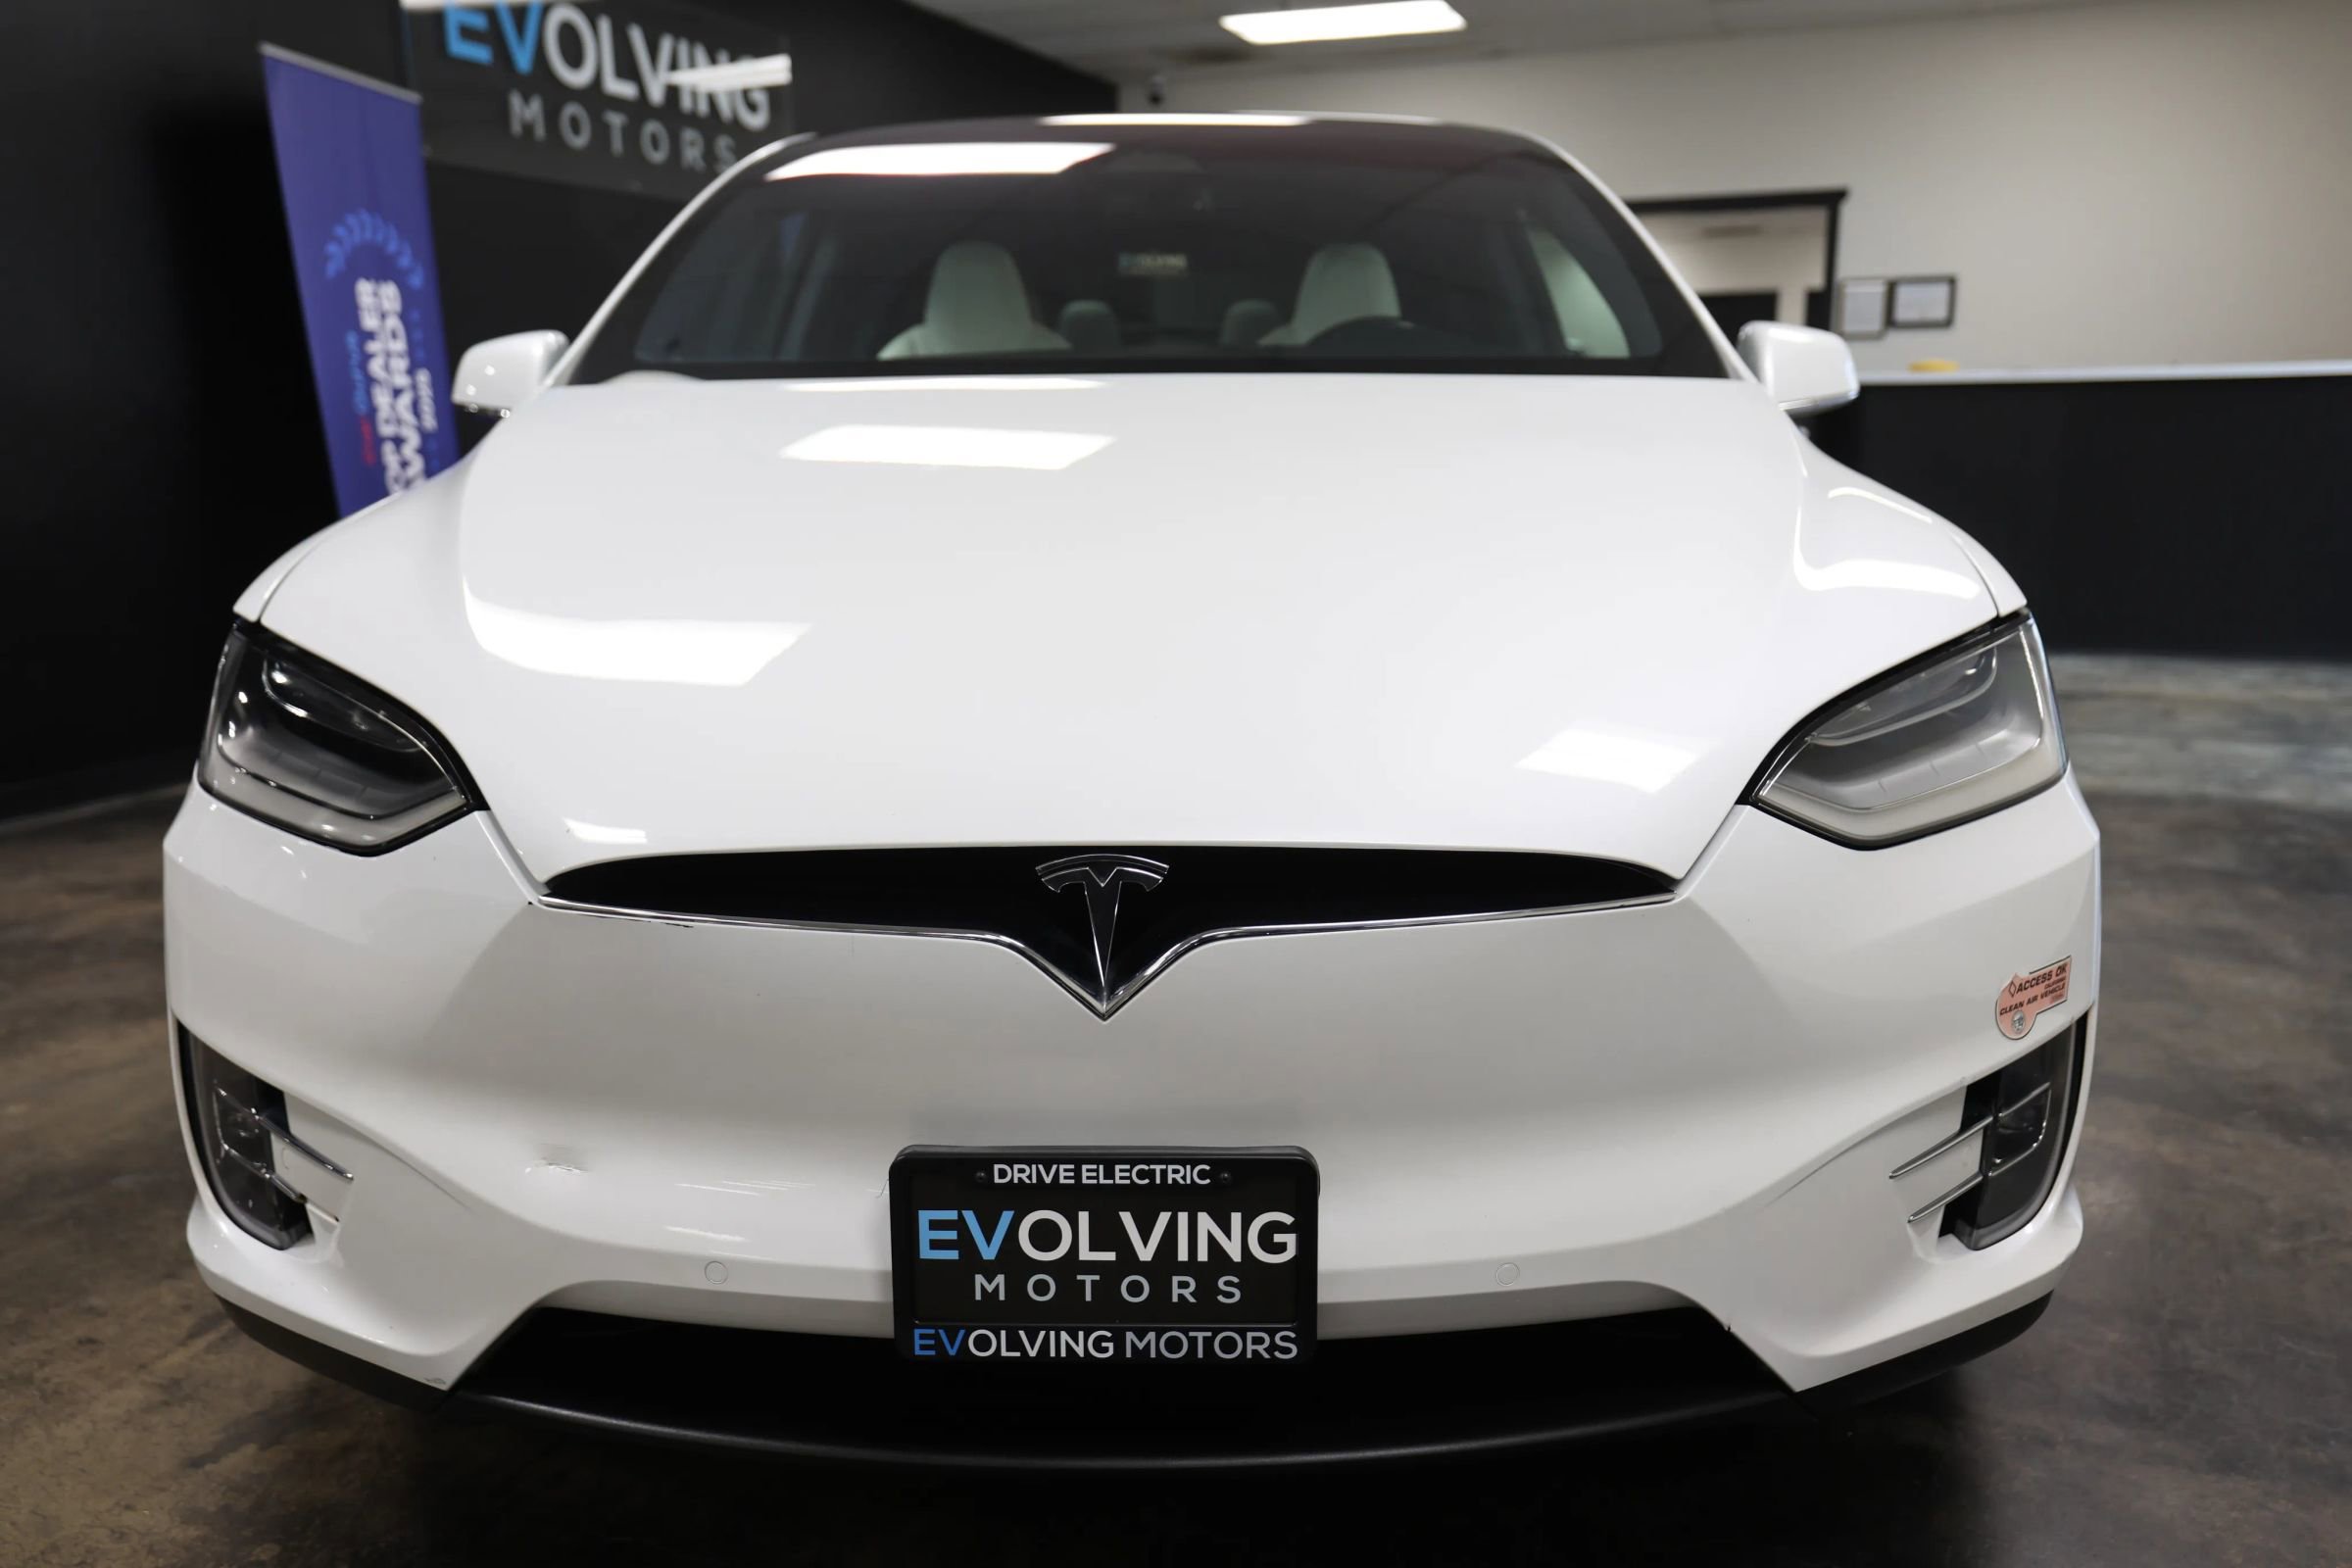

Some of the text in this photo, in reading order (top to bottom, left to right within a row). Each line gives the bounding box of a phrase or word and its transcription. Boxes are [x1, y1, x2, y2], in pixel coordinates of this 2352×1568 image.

[444, 0, 771, 131] EVOLVING
[509, 89, 738, 174] MOTORS
[354, 277, 399, 437] DEALER
[2016, 971, 2053, 994] ACCESS
[2055, 962, 2067, 977] OK
[1999, 1001, 2025, 1016] CLEAN
[2026, 995, 2038, 1005] AIR
[2040, 982, 2065, 999] VEHICLE
[994, 1164, 1210, 1184] DRIVE ELECTRIC
[918, 1210, 1297, 1263] EVOLVING
[975, 1274, 1241, 1303] MOTORS
[914, 1329, 1298, 1358] EVOLVING MOTORS
